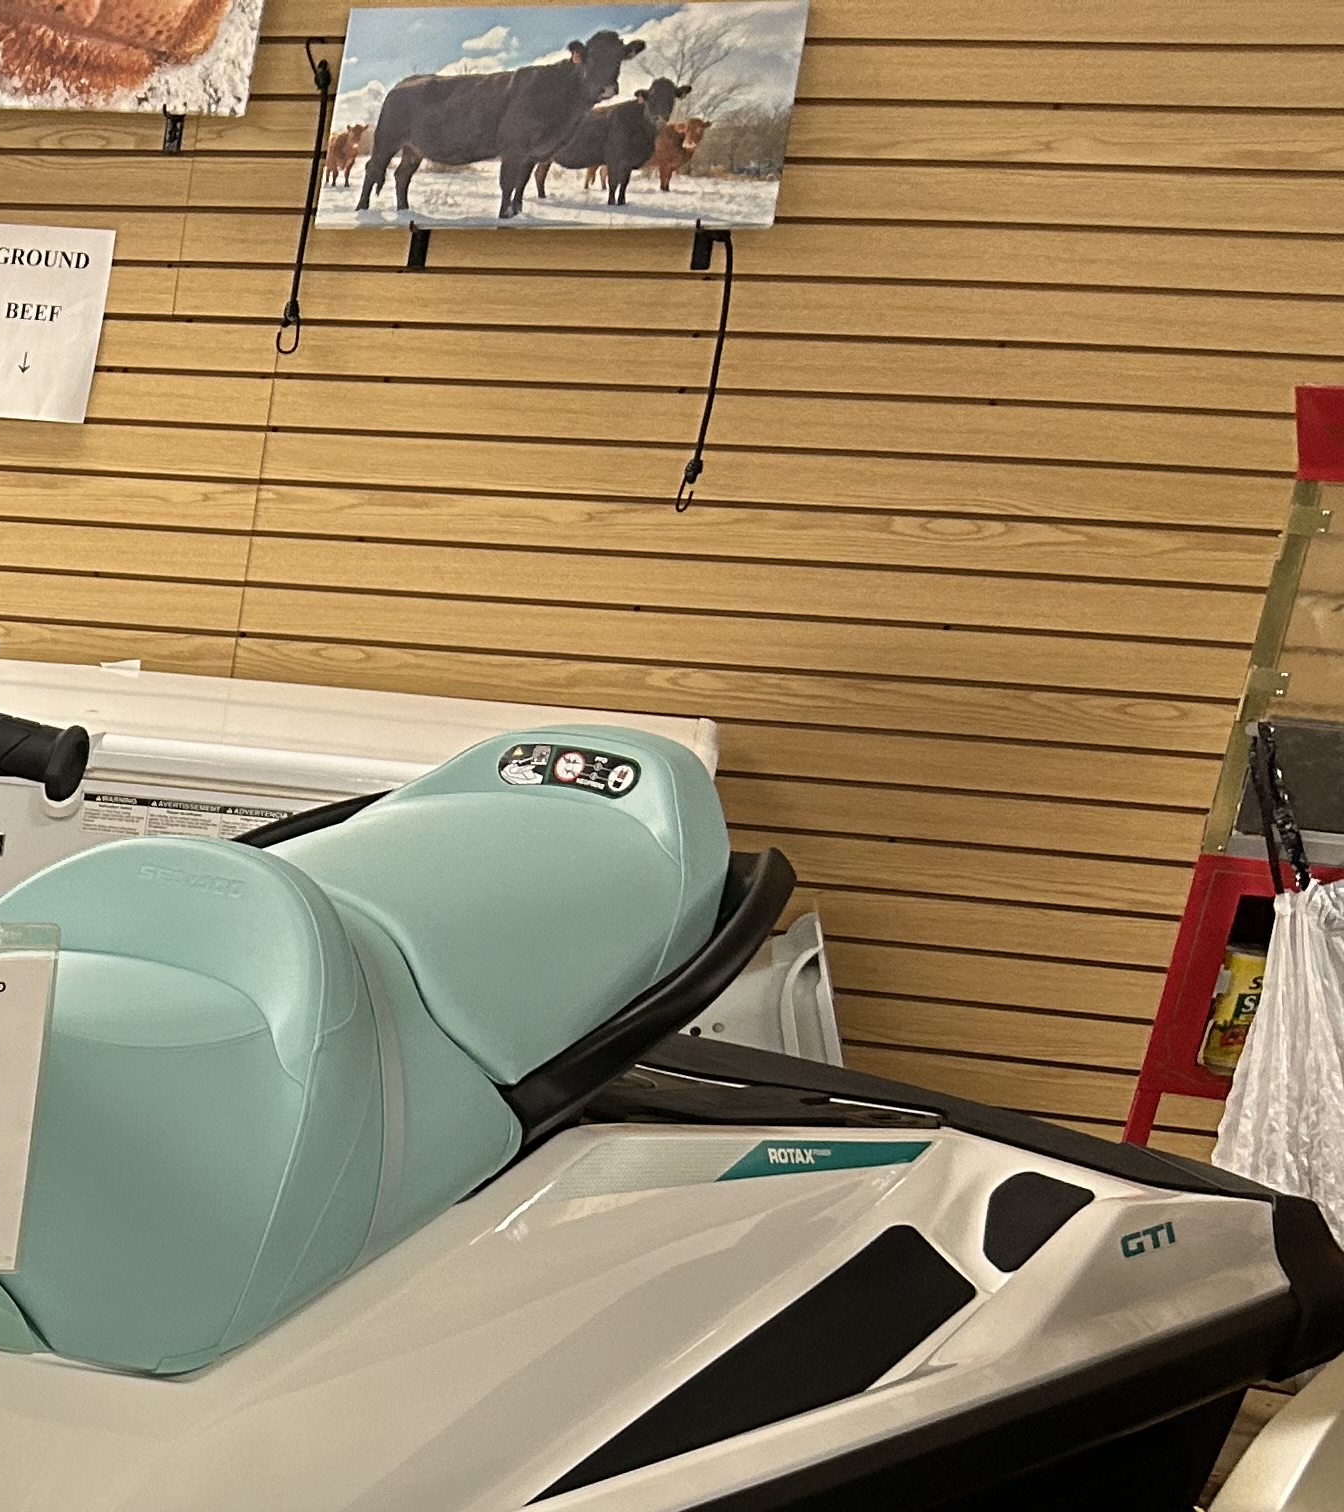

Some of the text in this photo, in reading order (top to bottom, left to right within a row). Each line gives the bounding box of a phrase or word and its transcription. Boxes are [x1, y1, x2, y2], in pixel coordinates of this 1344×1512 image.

[4, 301, 63, 322] BEEF
[767, 1147, 816, 1165] ROTAX
[1120, 1221, 1176, 1258] GTI
